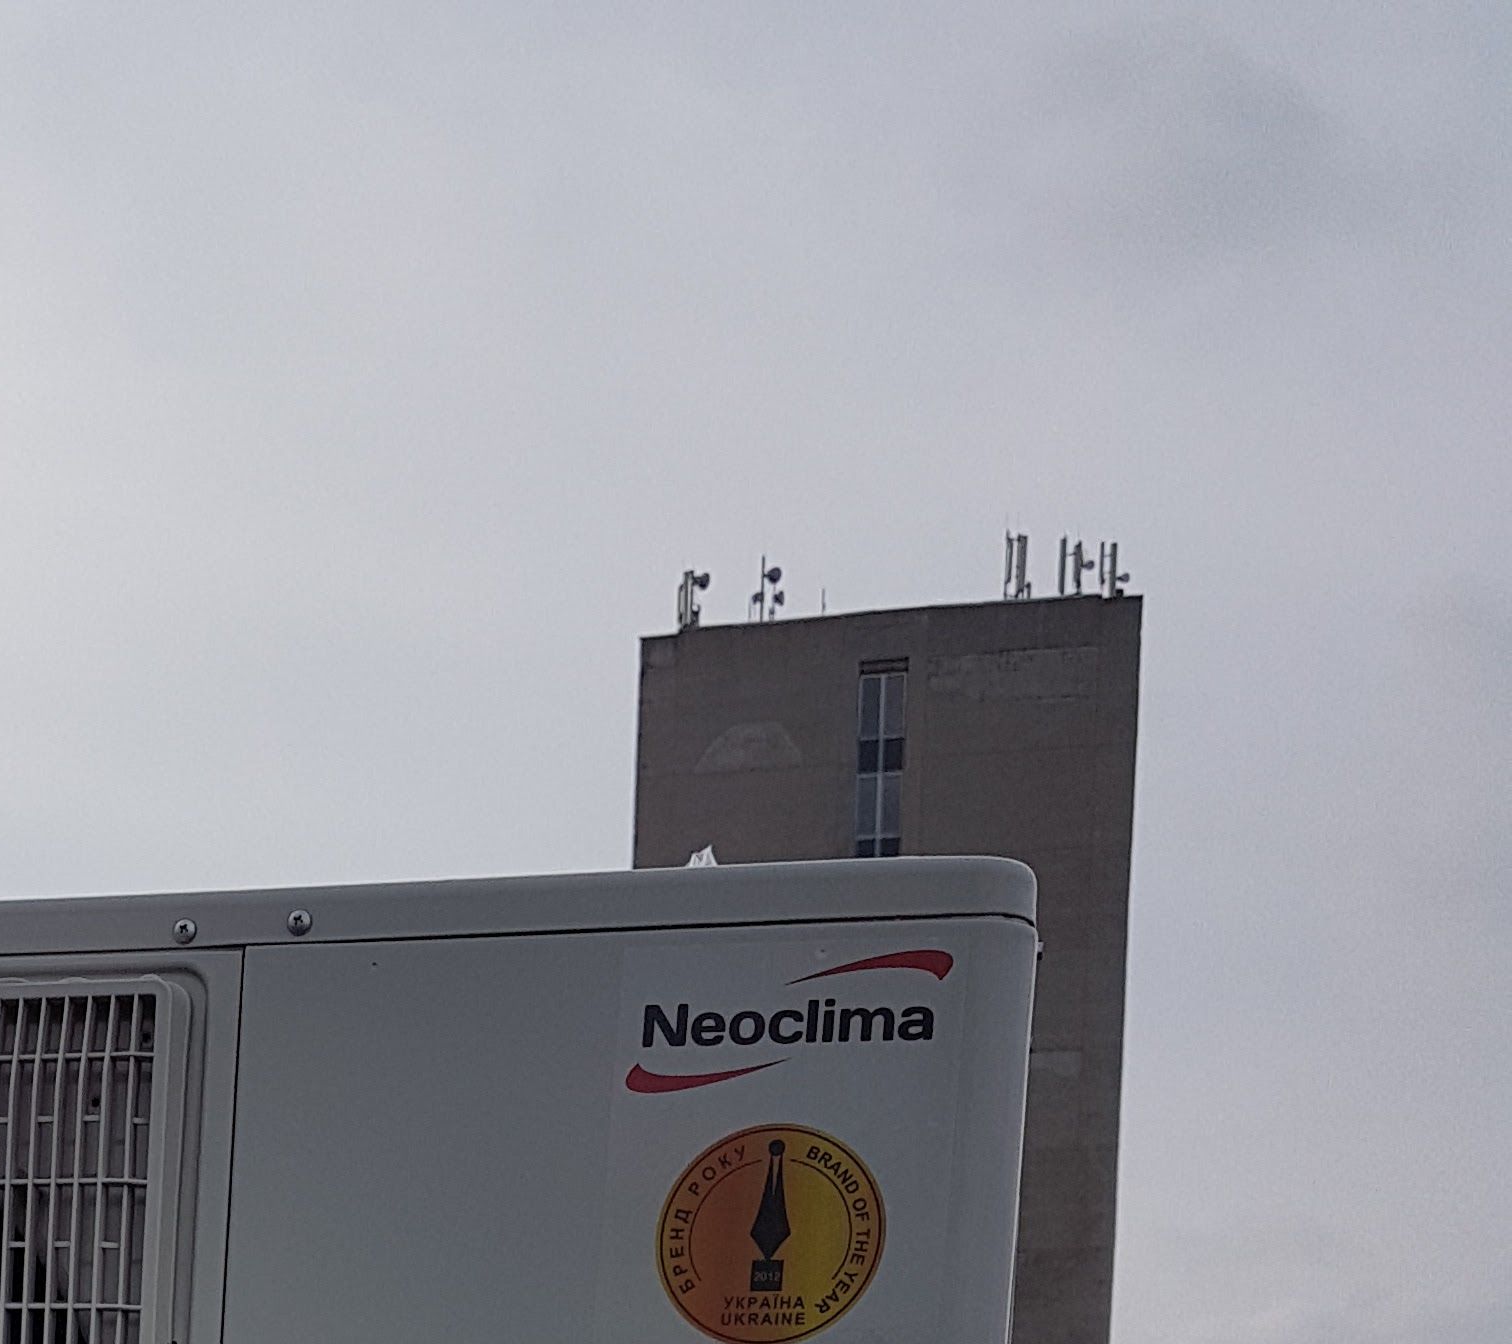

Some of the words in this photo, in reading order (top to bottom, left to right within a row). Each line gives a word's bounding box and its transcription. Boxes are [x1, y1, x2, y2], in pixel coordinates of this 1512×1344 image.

[641, 998, 935, 1048] Neoclima
[806, 1145, 860, 1195] BRAND
[669, 1208, 696, 1295] БРЕНД
[688, 1144, 746, 1197] РОКУ
[852, 1197, 870, 1222] OF
[850, 1228, 871, 1267] THE
[723, 1293, 805, 1310] УКРАЇНА
[814, 1270, 859, 1314] YEAR
[720, 1312, 806, 1326] UKRAINE
